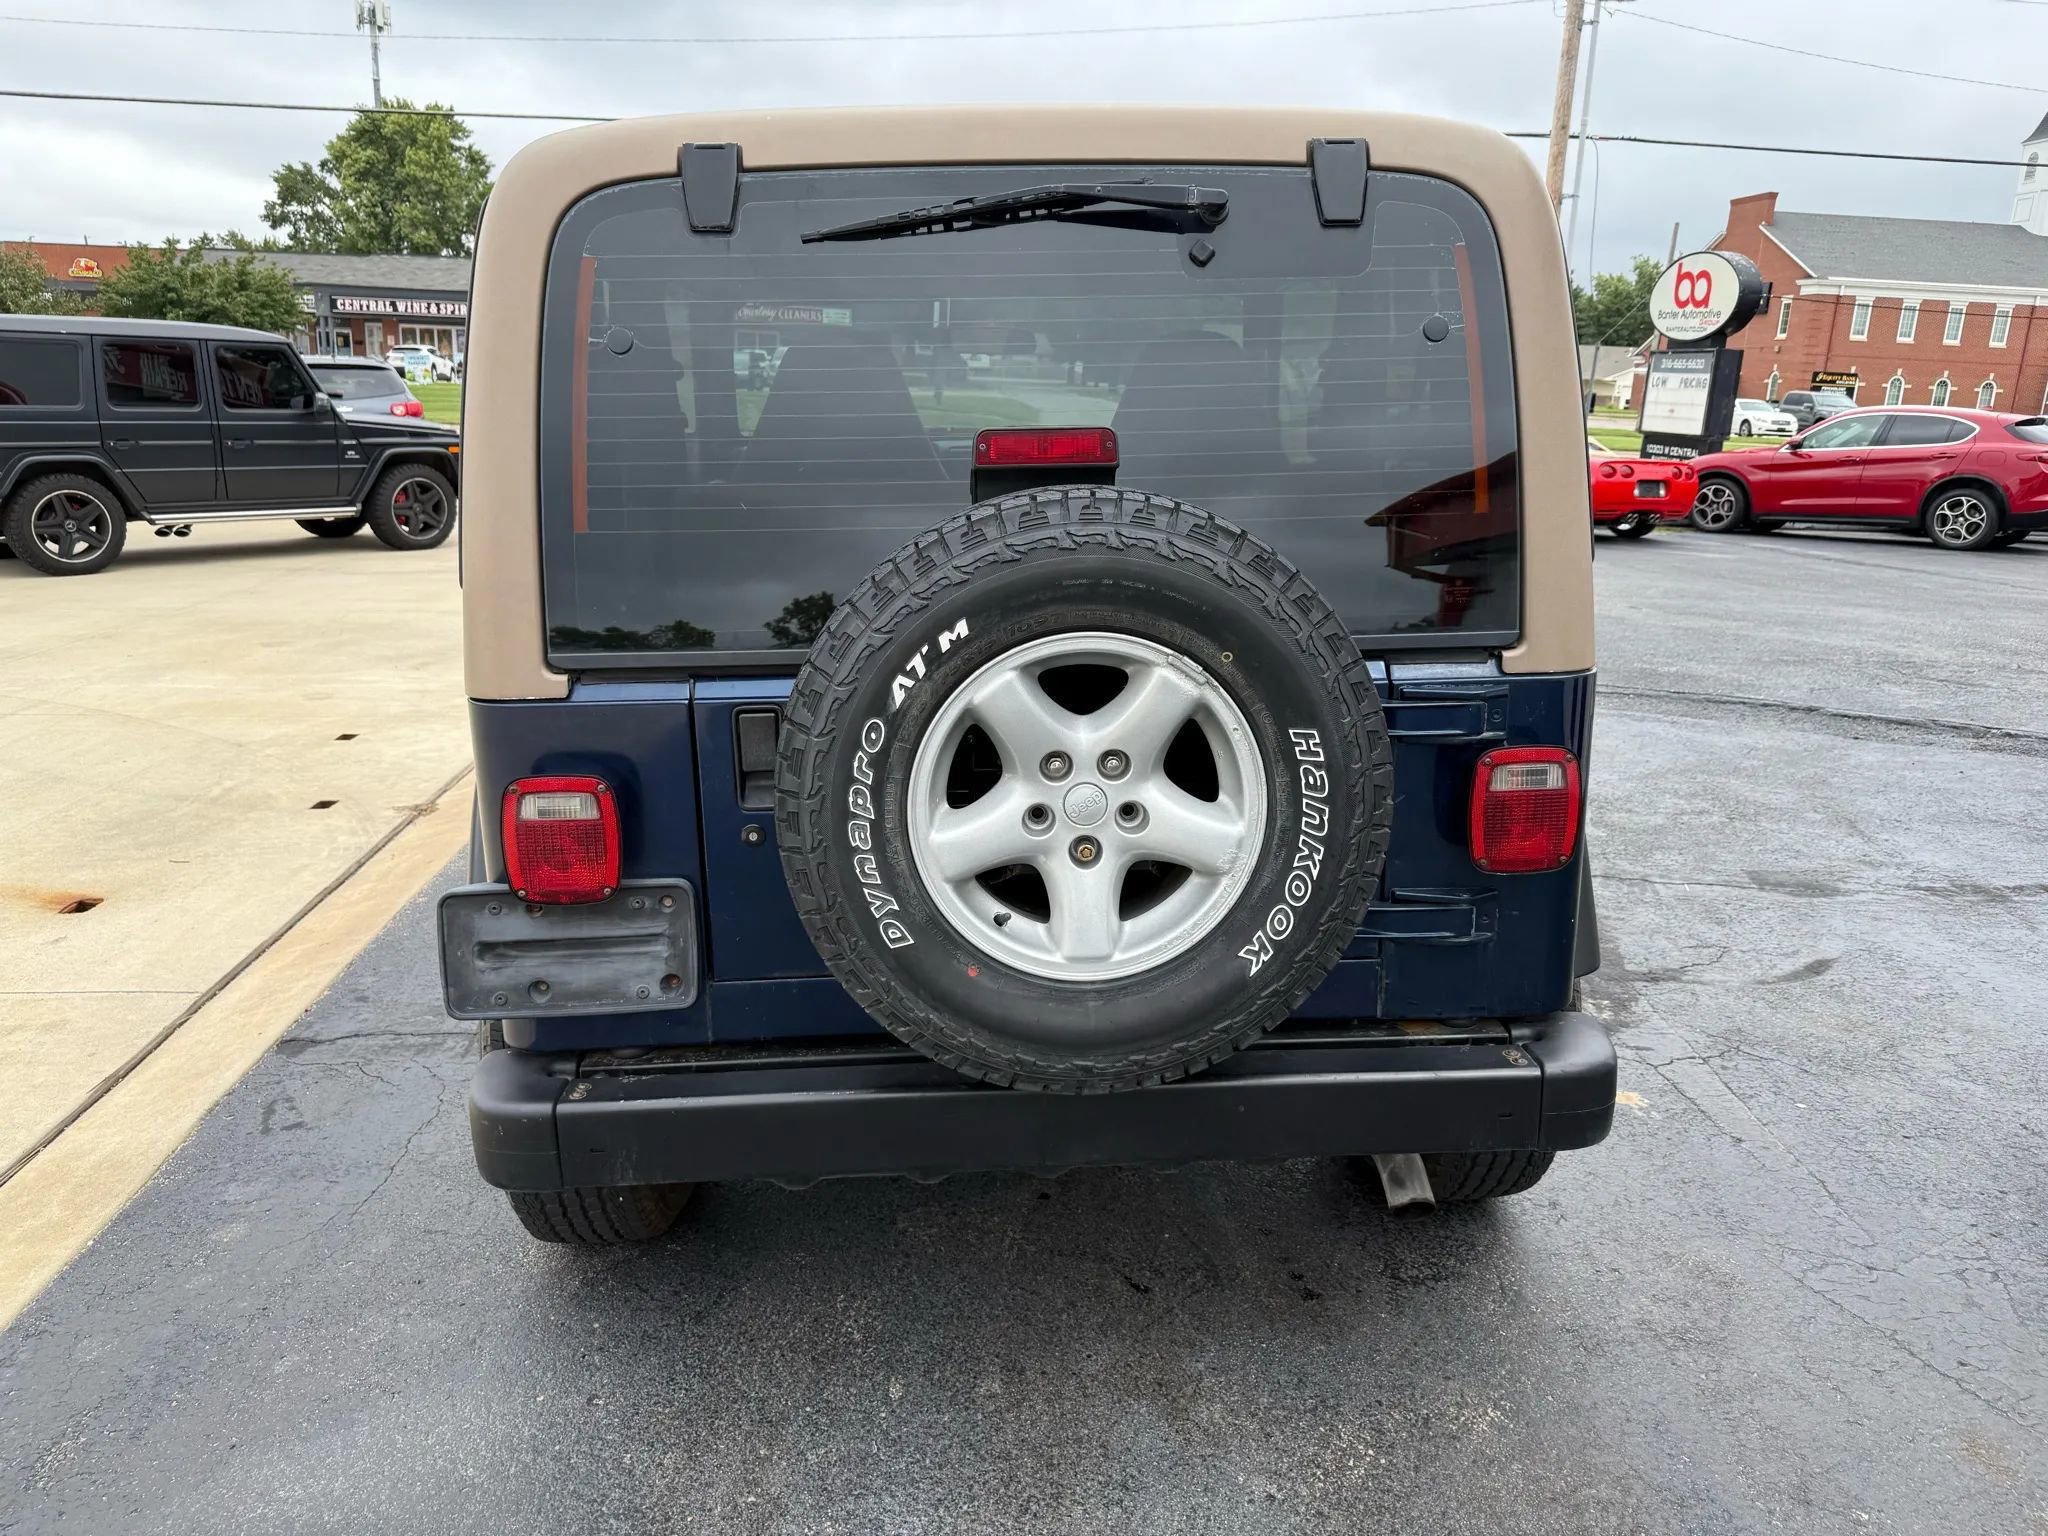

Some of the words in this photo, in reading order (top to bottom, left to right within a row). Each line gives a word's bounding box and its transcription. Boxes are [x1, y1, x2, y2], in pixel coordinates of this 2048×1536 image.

[337, 298, 393, 313] CENTRAL
[395, 301, 428, 314] WINE
[1658, 310, 1680, 320] Banter
[1681, 309, 1722, 319] Automotive
[1651, 377, 1669, 388] LOW
[1679, 377, 1708, 389] PRICING
[1070, 790, 1103, 818] Jeep
